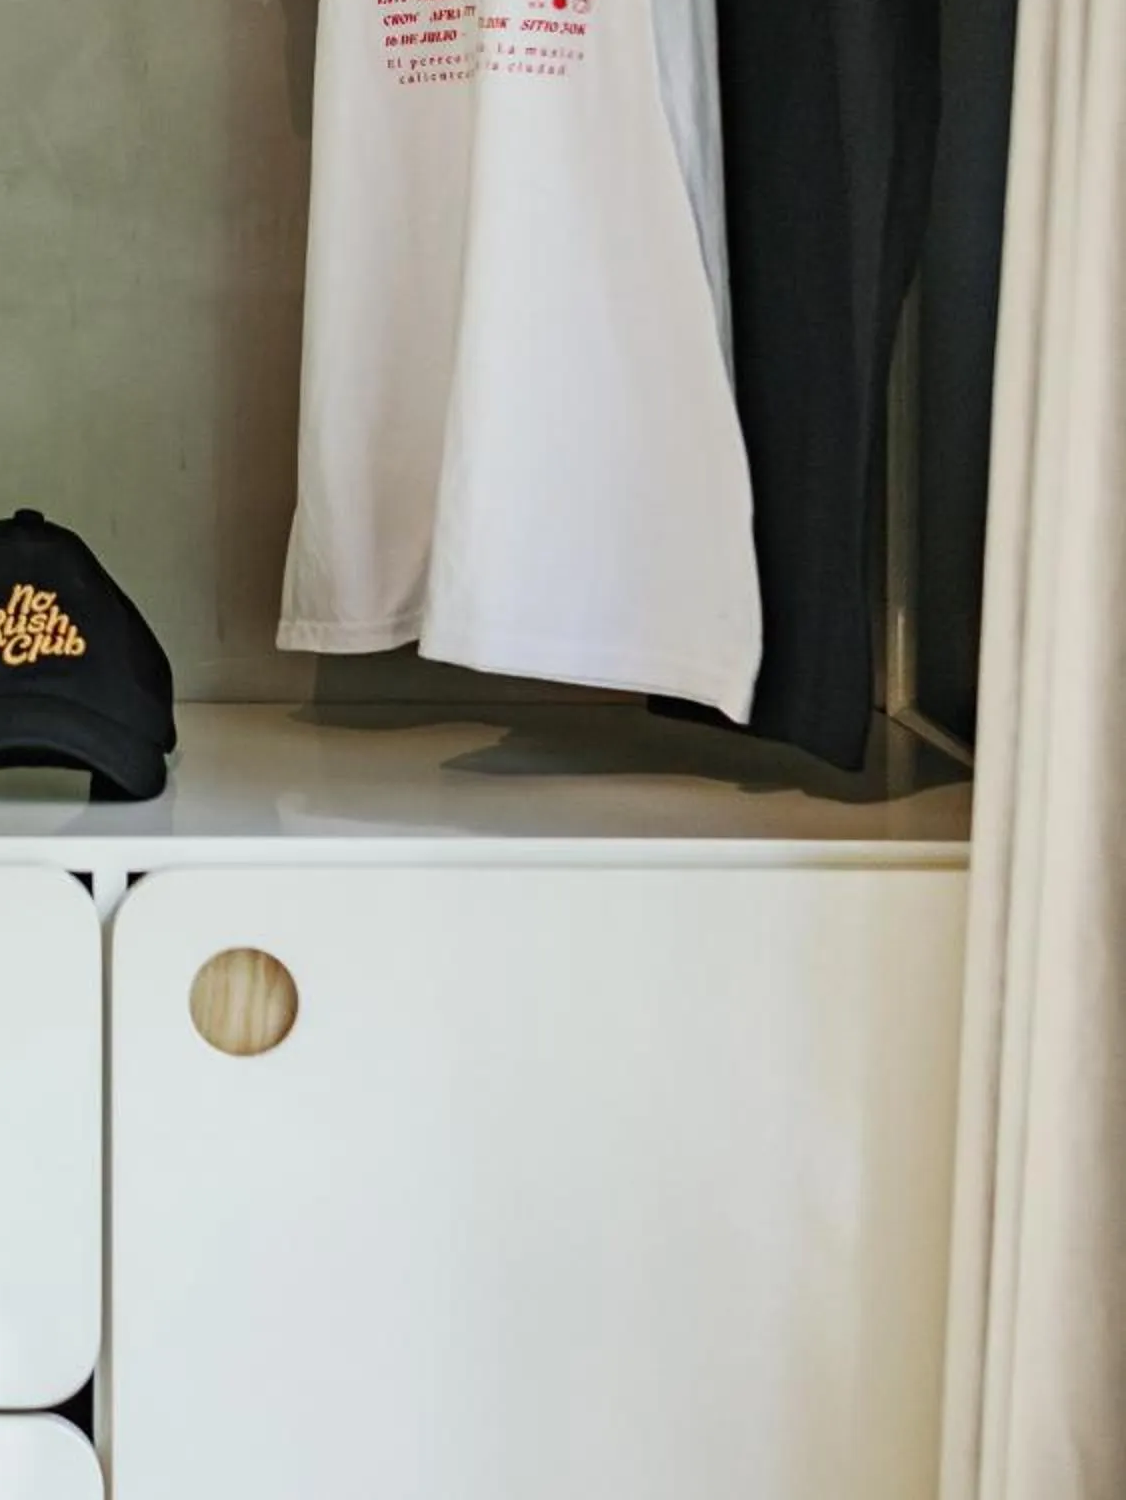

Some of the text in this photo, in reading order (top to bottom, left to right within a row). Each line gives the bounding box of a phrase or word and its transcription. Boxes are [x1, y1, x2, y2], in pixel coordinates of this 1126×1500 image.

[401, 32, 417, 45] DE
[420, 28, 458, 44] JULIO
[2, 625, 86, 666] Club
